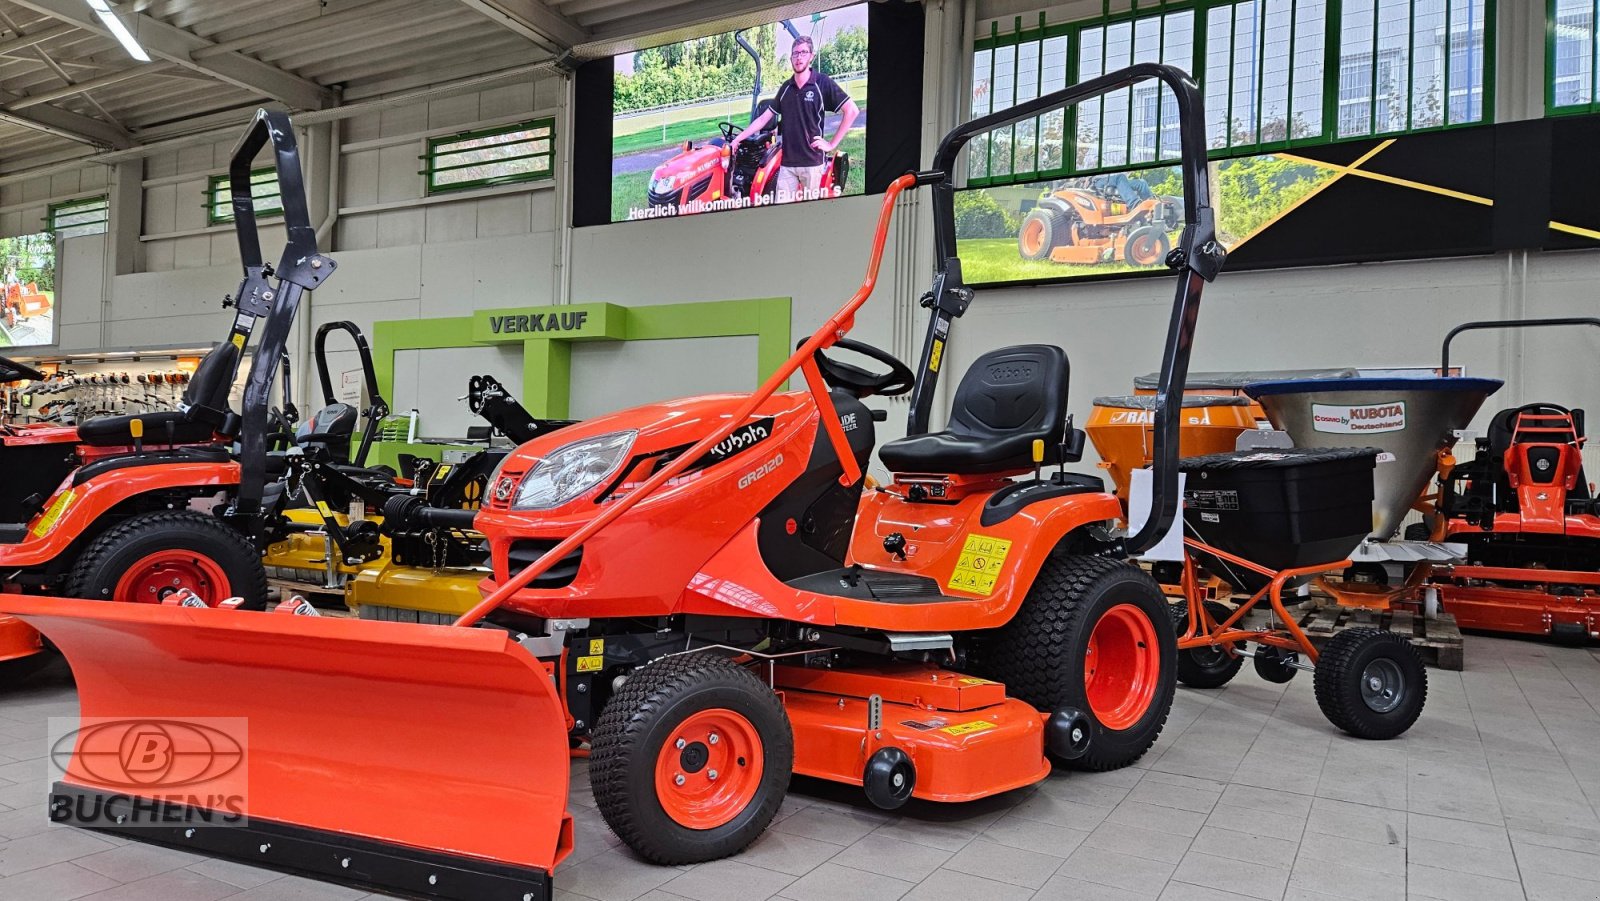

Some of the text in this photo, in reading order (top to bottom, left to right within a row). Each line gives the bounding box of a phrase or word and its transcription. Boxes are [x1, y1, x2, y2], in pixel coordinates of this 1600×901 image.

[629, 203, 677, 219] Herzlich
[677, 196, 751, 215] willkommen
[754, 190, 775, 206] bei
[489, 311, 588, 334] VERKAUF
[1341, 416, 1350, 426] by
[1349, 405, 1403, 420] KUBOTA
[1350, 420, 1403, 430] Deutschland
[710, 425, 768, 455] Kubota
[737, 452, 785, 490] GR2120
